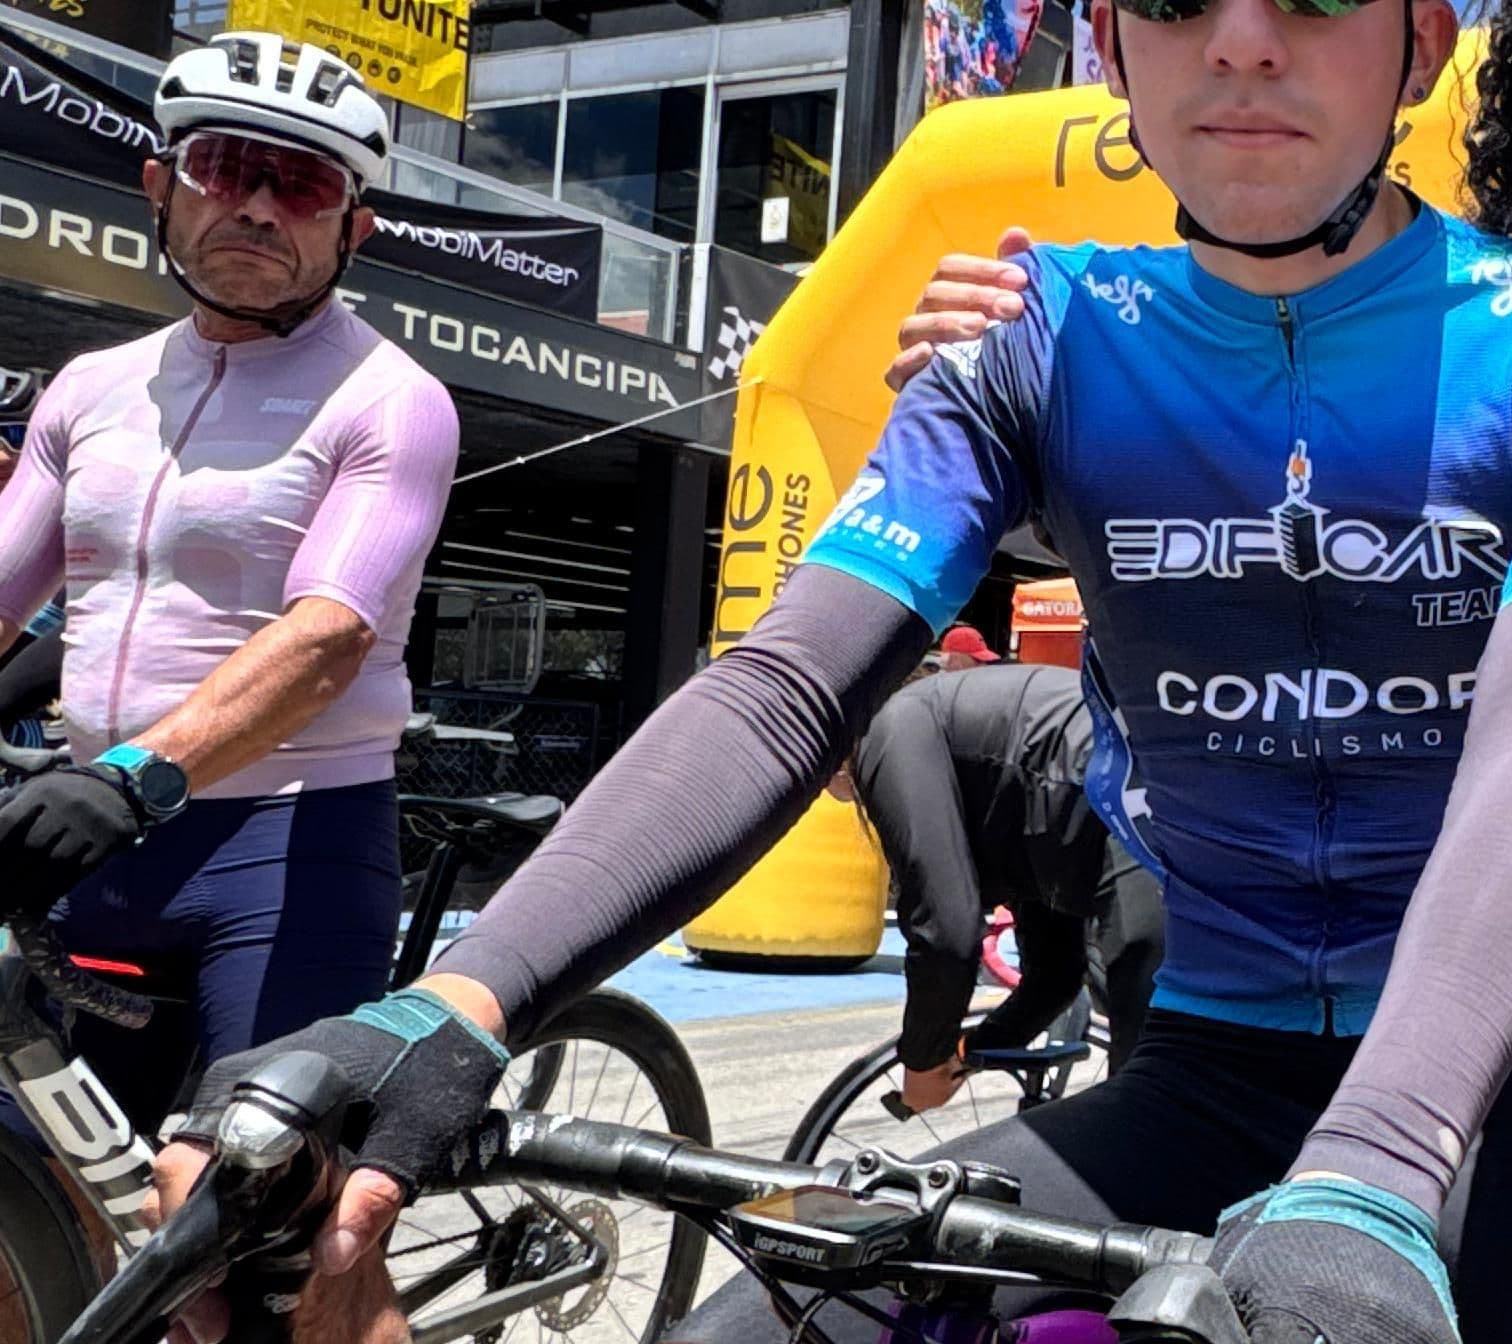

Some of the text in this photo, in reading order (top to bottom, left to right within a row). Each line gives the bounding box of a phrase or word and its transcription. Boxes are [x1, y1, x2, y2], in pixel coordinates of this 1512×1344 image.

[373, 215, 579, 287] MobiMatter
[393, 302, 680, 408] TOCANCIPA
[1207, 728, 1443, 758] CICLISMO
